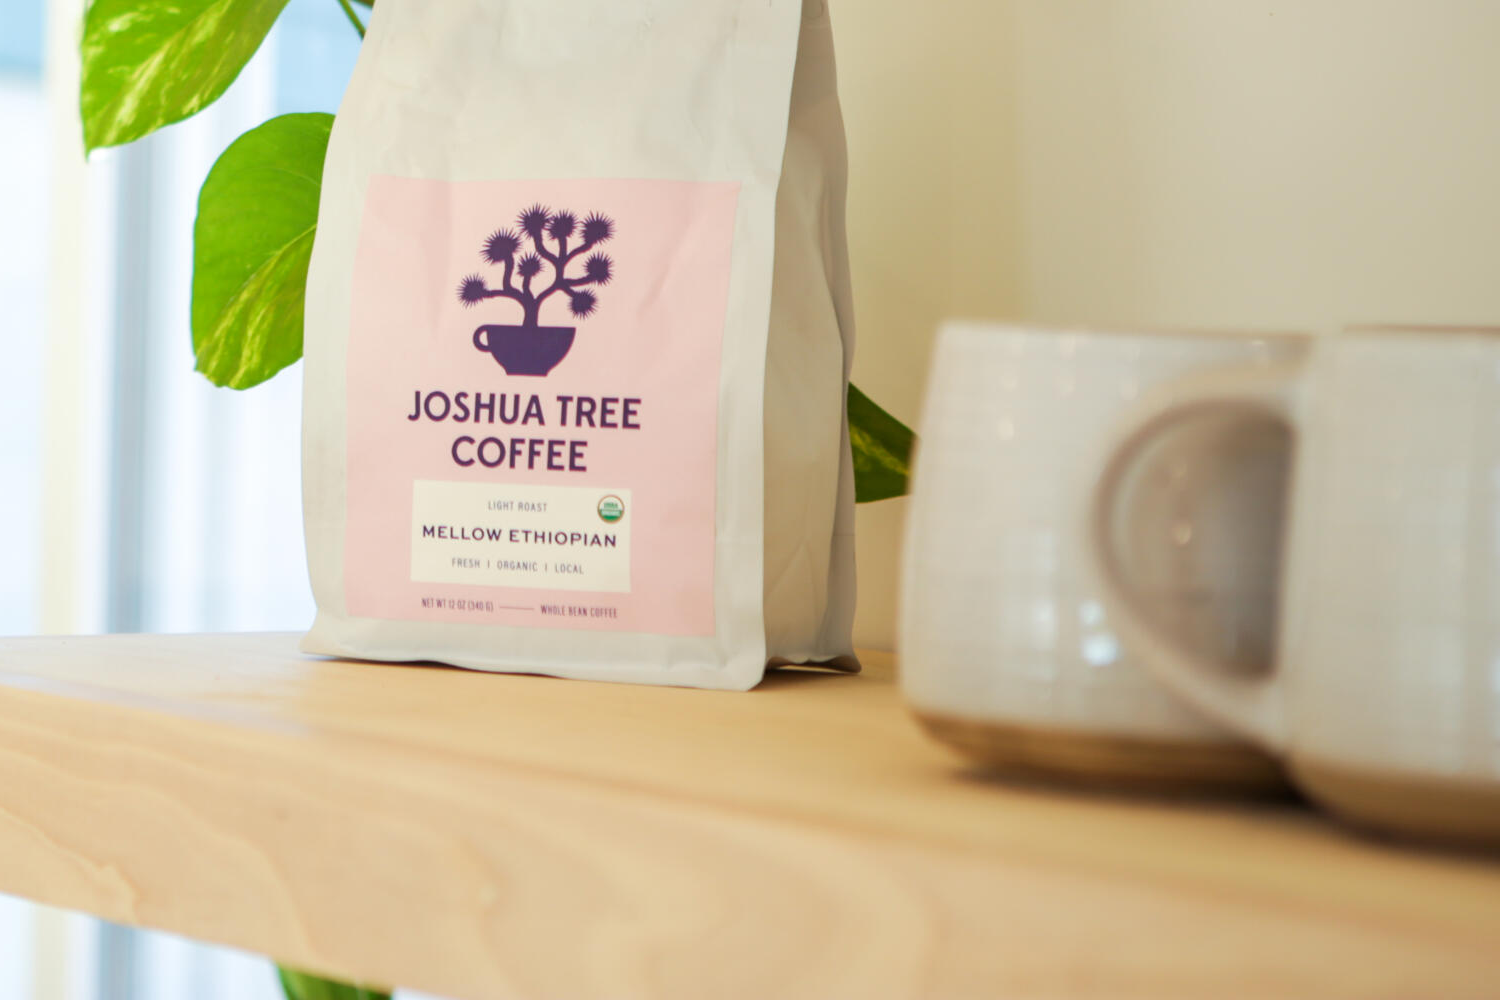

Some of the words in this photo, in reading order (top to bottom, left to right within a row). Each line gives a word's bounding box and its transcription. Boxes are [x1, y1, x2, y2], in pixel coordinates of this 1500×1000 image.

[407, 390, 545, 426] JOSHUA
[556, 395, 642, 430] TREE
[451, 435, 588, 472] COFFEE
[487, 500, 514, 511] LIGHT
[518, 501, 547, 512] ROAST
[422, 525, 502, 542] MELLOW
[509, 529, 617, 548] ETHIOPIAN
[451, 557, 480, 569] FRESH
[497, 559, 538, 571] ORGANIC
[555, 562, 584, 575] LOCAL
